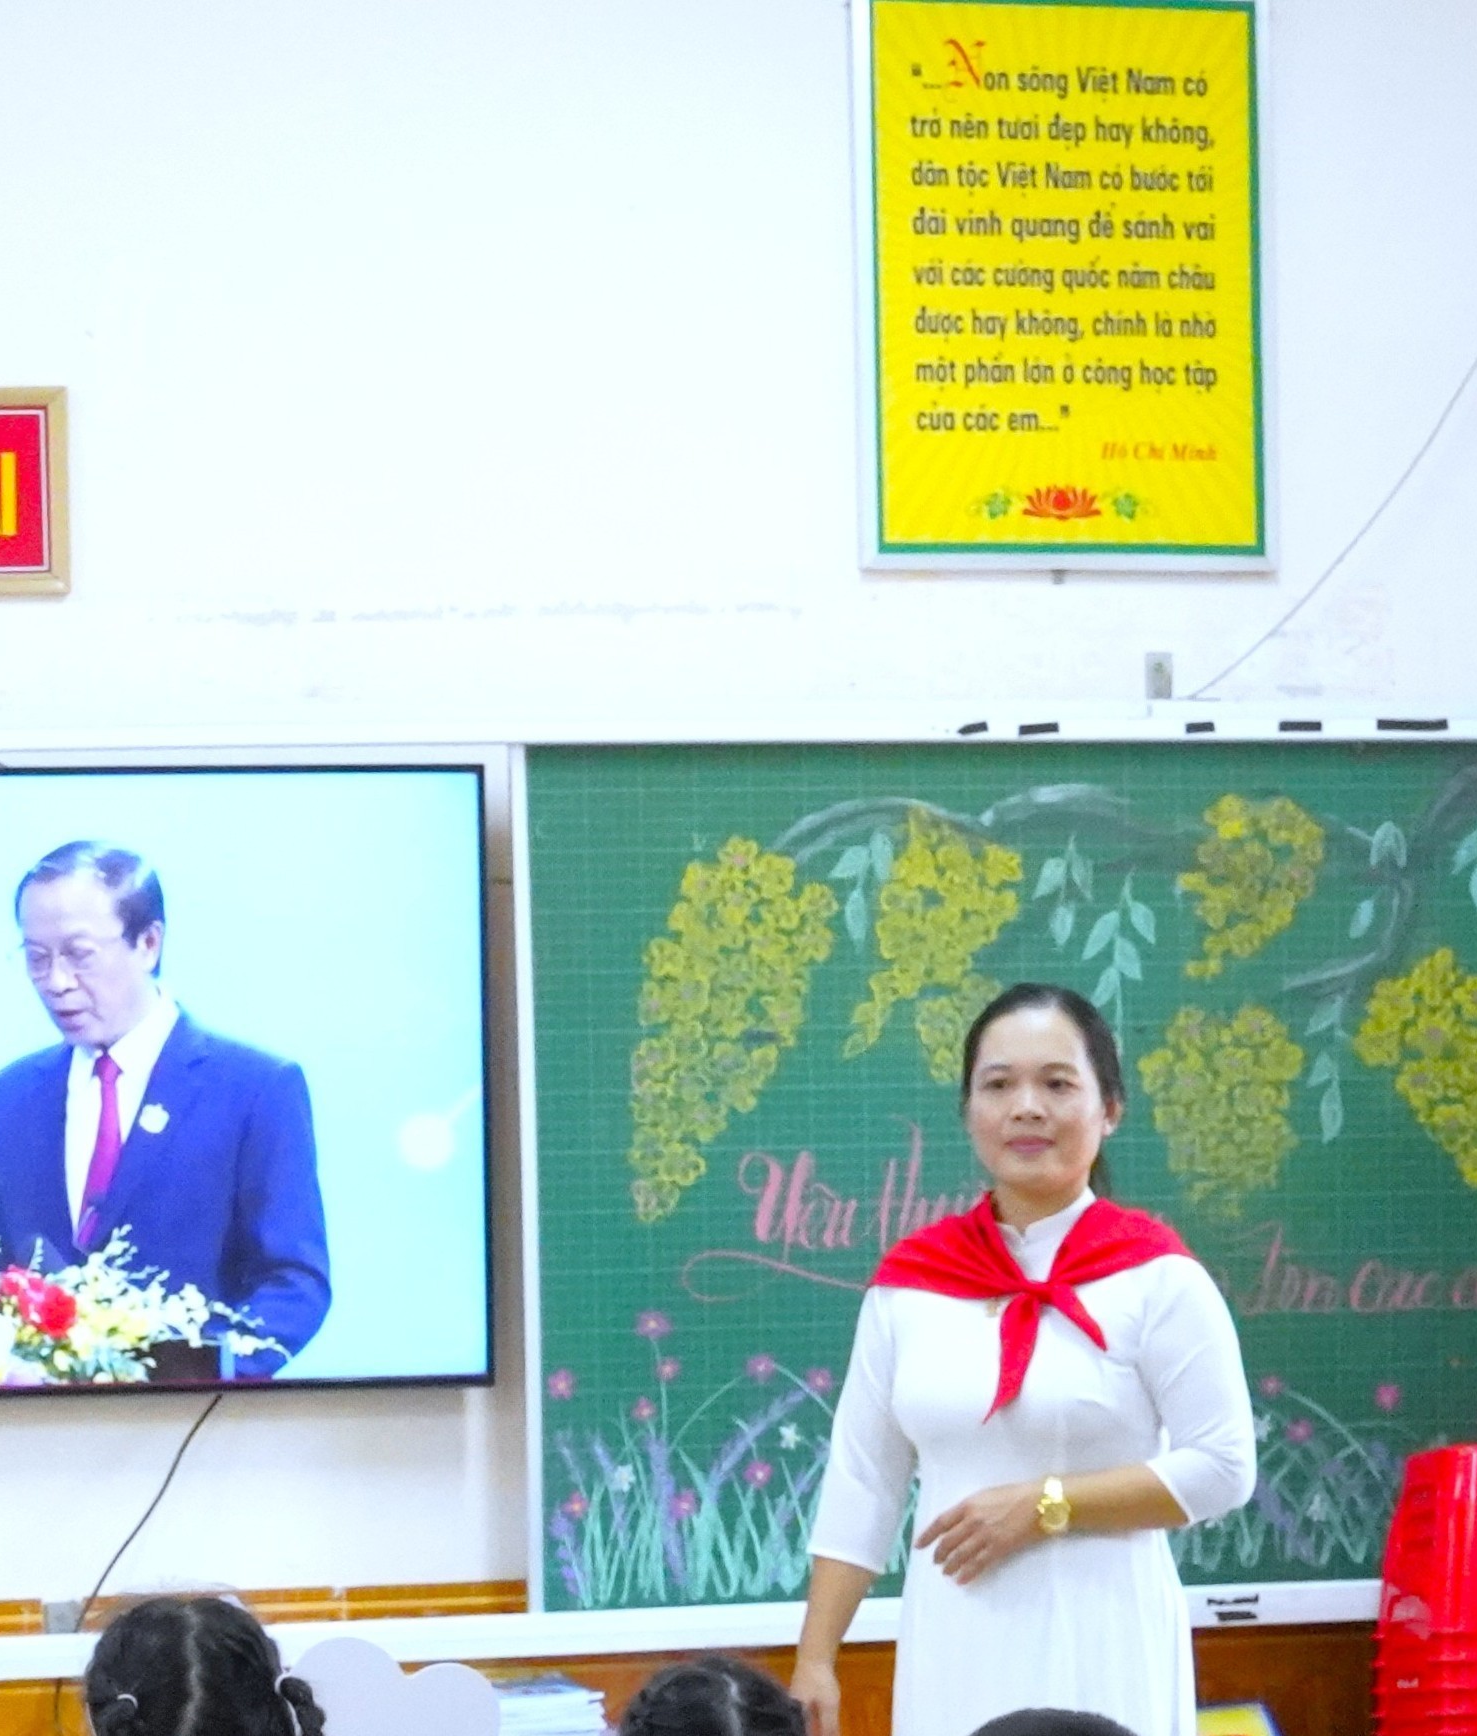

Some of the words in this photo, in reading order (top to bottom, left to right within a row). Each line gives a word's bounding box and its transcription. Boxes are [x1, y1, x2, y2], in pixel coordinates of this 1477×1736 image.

[1076, 66, 1118, 103] Việt
[1126, 68, 1175, 95] Nam
[1183, 69, 1208, 97] có
[949, 113, 989, 139] nên
[1048, 111, 1087, 151] đẹp
[1094, 114, 1132, 149] hay
[911, 160, 949, 187] dân
[957, 160, 989, 196] tộc
[996, 161, 1038, 198] Việt
[1046, 161, 1091, 189] Nam
[1099, 163, 1123, 190] có
[955, 209, 1002, 237] vinh
[1010, 216, 1080, 245] quang
[1088, 202, 1115, 239] để
[1122, 211, 1175, 241] sánh
[1183, 213, 1216, 242] vai
[951, 258, 986, 287] các
[972, 308, 1007, 341] hay
[916, 355, 956, 391] một
[1139, 359, 1177, 394] học
[963, 404, 1000, 431] các
